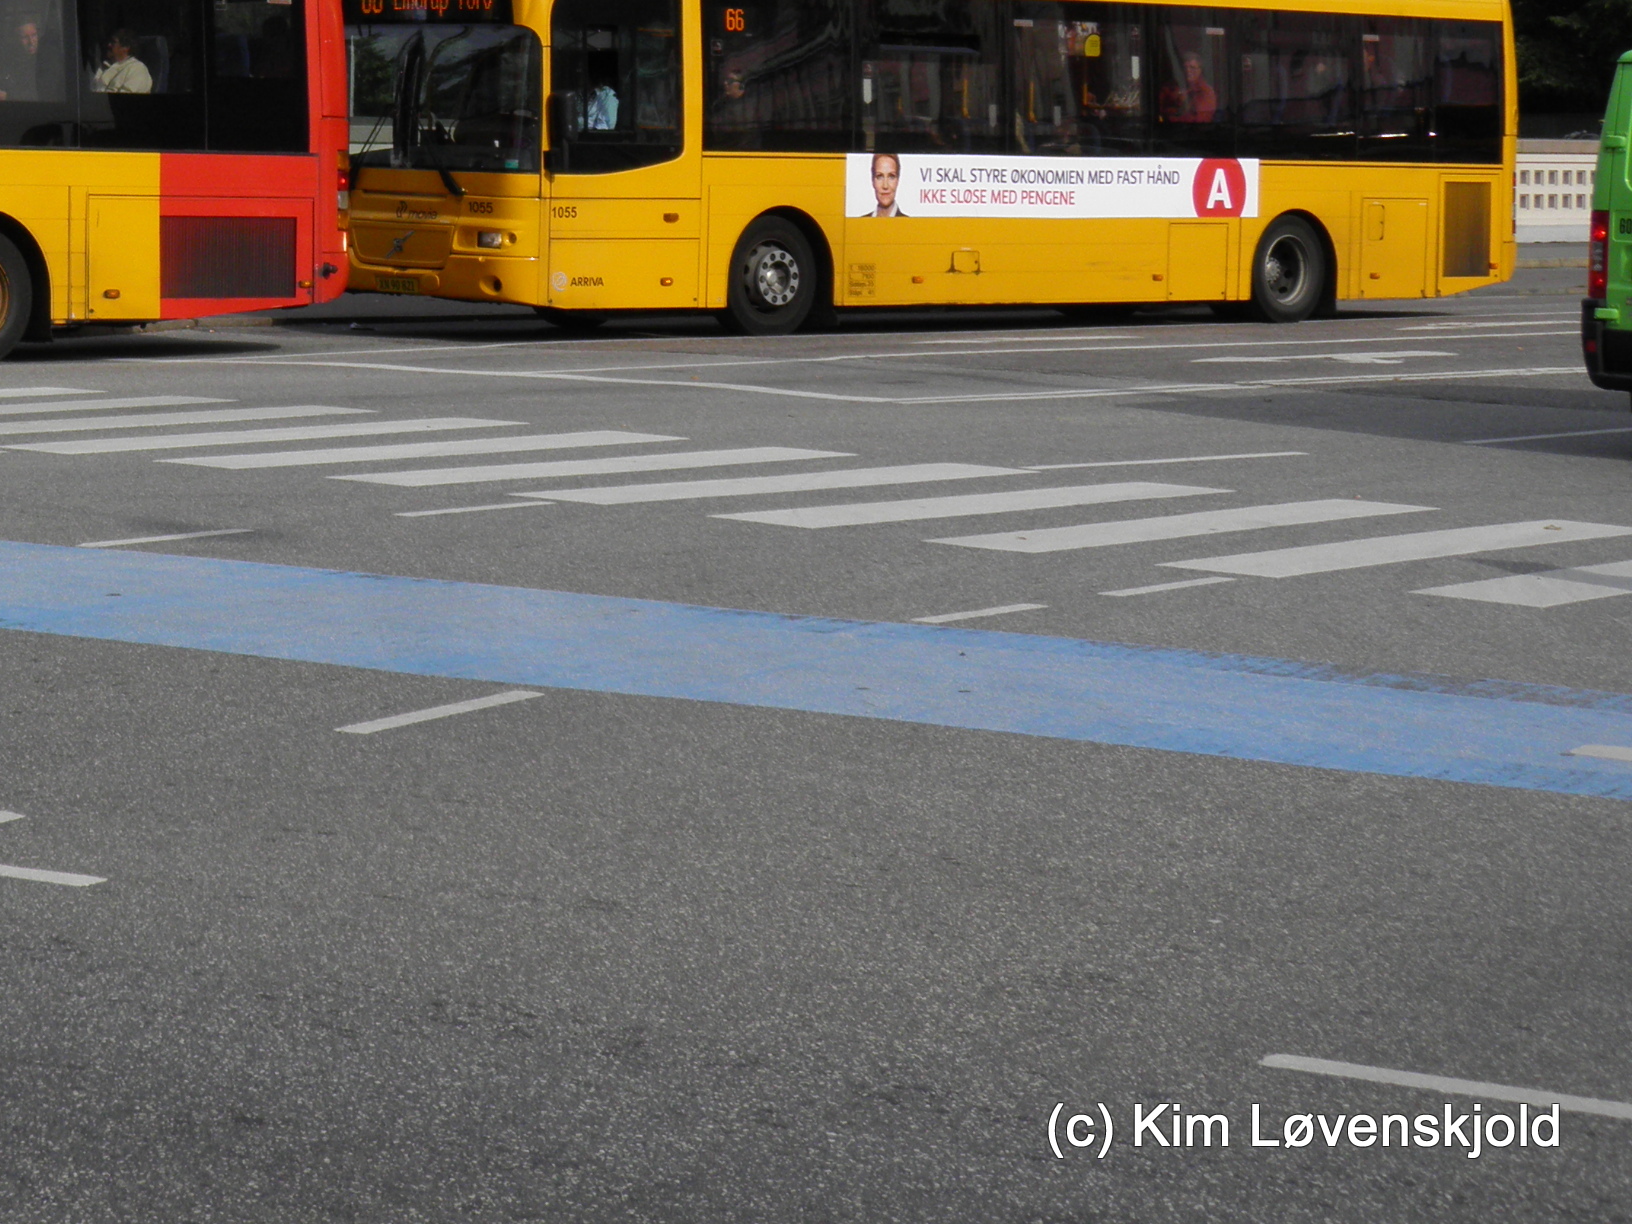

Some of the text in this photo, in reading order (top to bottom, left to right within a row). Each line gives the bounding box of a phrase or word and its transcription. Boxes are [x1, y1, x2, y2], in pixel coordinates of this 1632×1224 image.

[726, 8, 745, 31] 66
[920, 164, 1180, 185] VI SKAL STYRE ØKONOMIEN MED FAST HÅND
[920, 188, 1076, 205] IKKE SLØSE MED PENGENE
[1206, 168, 1233, 210] A
[469, 201, 494, 214] 1055
[551, 206, 578, 219] 1055
[570, 276, 604, 287] ARRIVA
